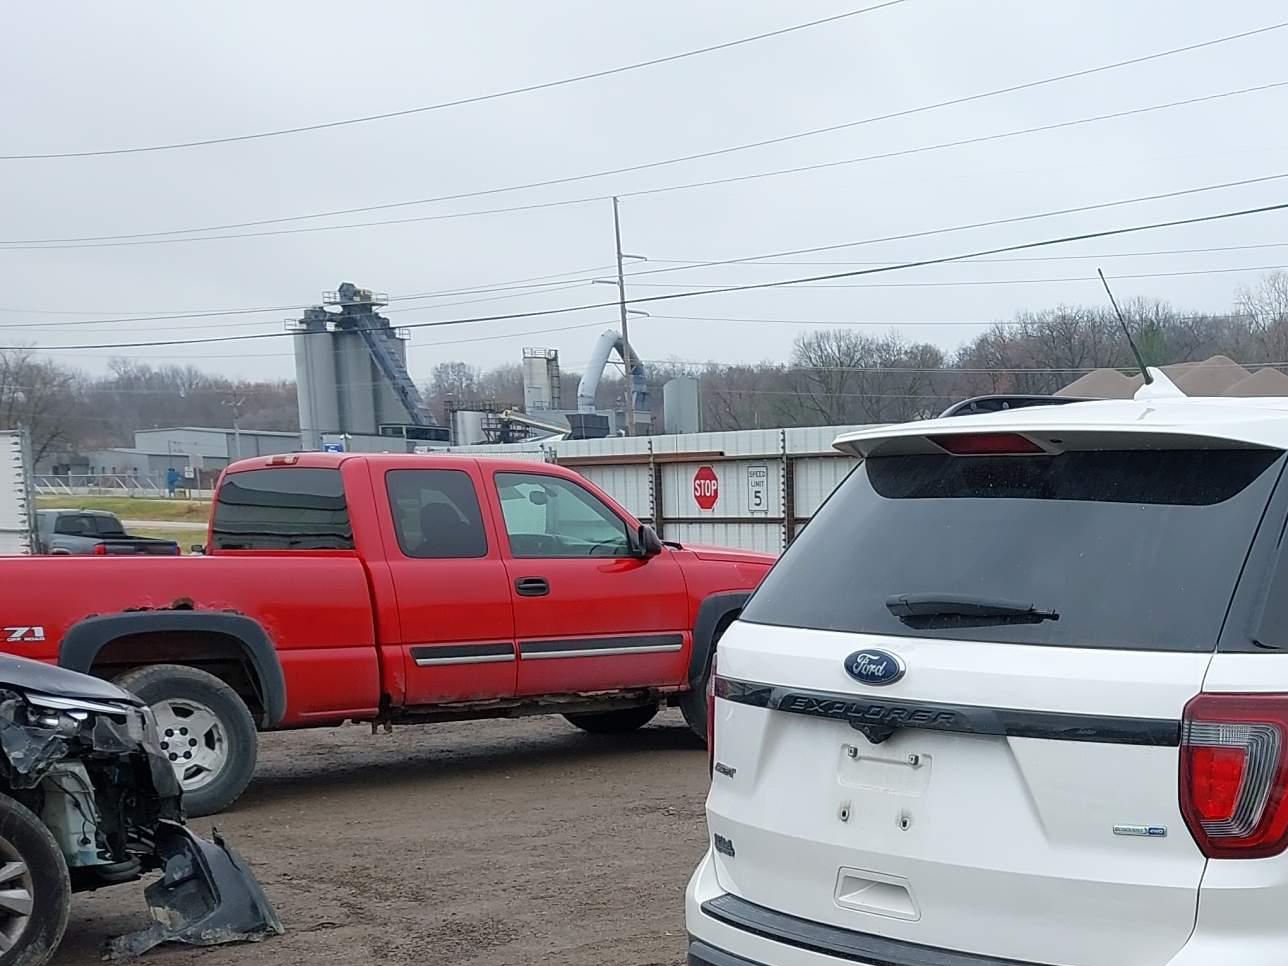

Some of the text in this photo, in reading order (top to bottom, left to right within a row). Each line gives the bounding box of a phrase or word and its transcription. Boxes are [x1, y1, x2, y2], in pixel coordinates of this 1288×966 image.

[695, 480, 717, 496] STOP
[754, 491, 762, 506] 5
[852, 653, 887, 676] Ford
[791, 696, 957, 724] EXPLORER
